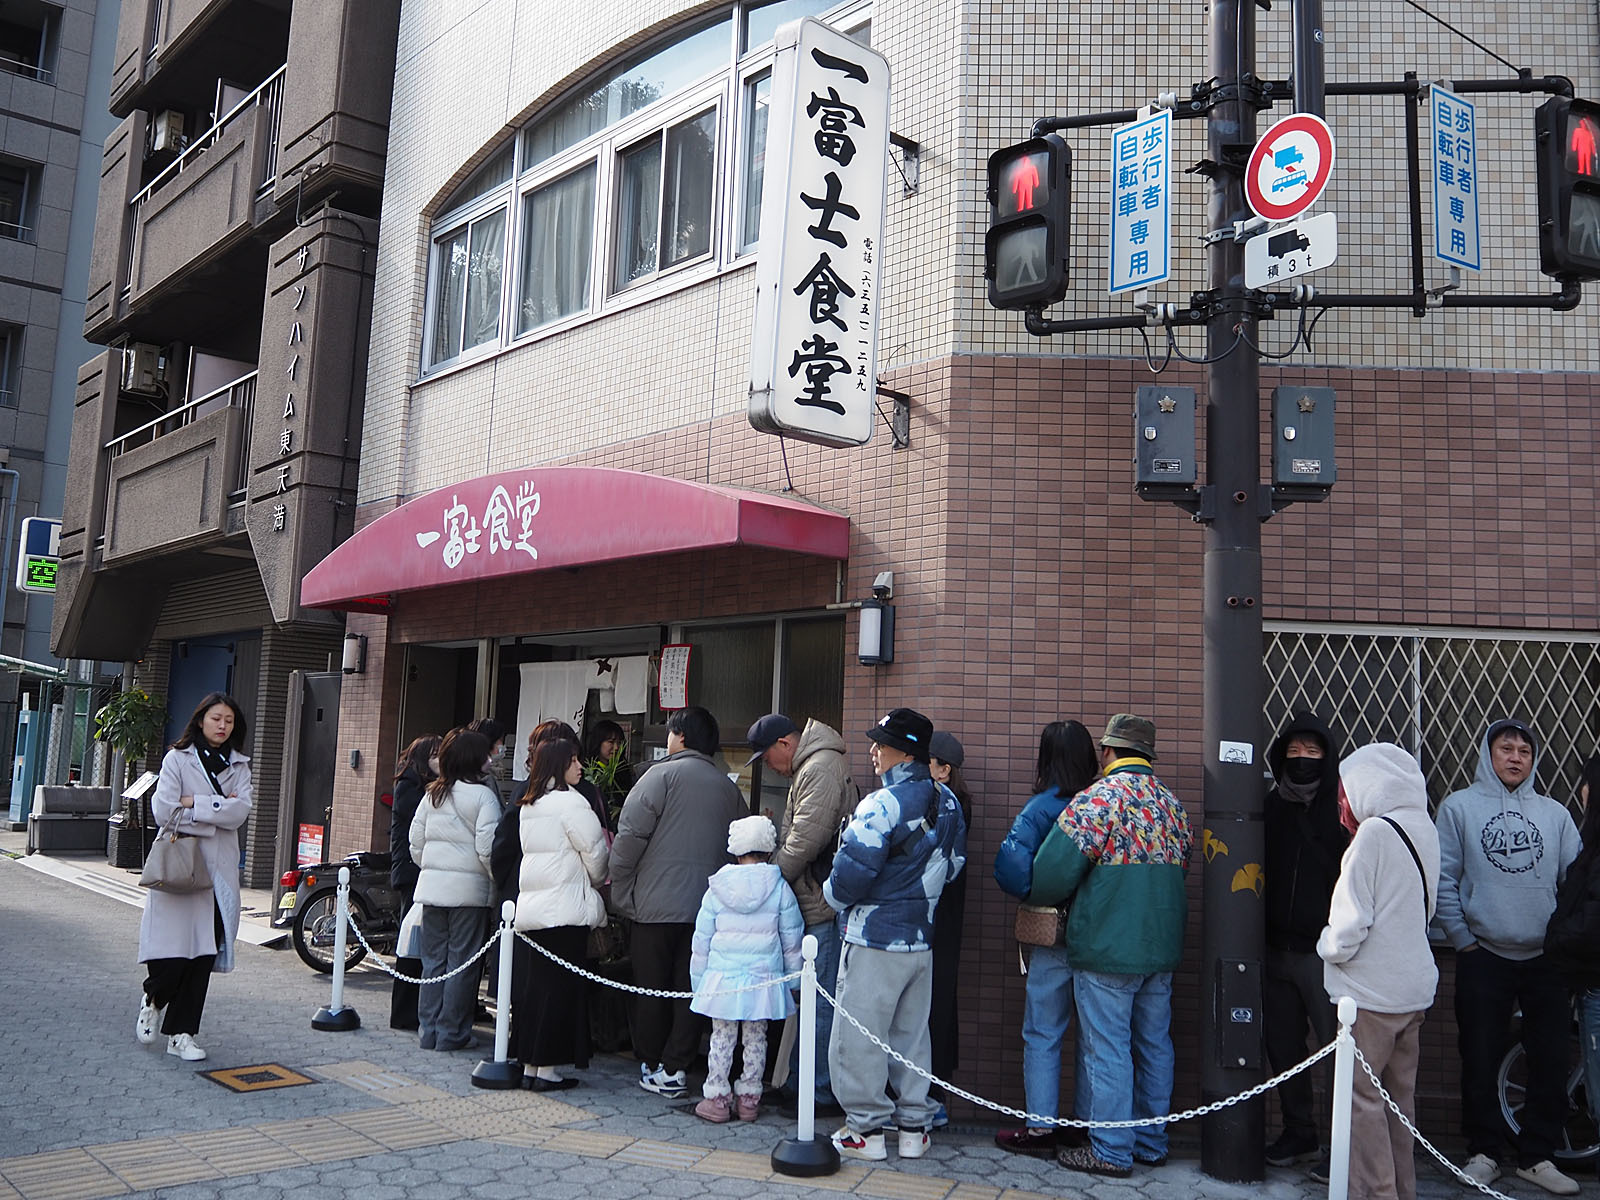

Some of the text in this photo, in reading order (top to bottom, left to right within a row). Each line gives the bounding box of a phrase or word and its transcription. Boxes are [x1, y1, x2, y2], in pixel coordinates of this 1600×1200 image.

[1118, 135, 1139, 217] 自転車
[1142, 126, 1163, 210] 歩行者
[1437, 102, 1455, 187] 自転車
[1455, 109, 1473, 194] 歩行者
[787, 47, 870, 416] 一富士食堂
[1129, 219, 1150, 278] 専用
[1450, 196, 1467, 257] 専用
[273, 246, 308, 532] サンハイム東天満
[415, 480, 541, 569] 一富士食堂
[26, 558, 58, 588] 空
